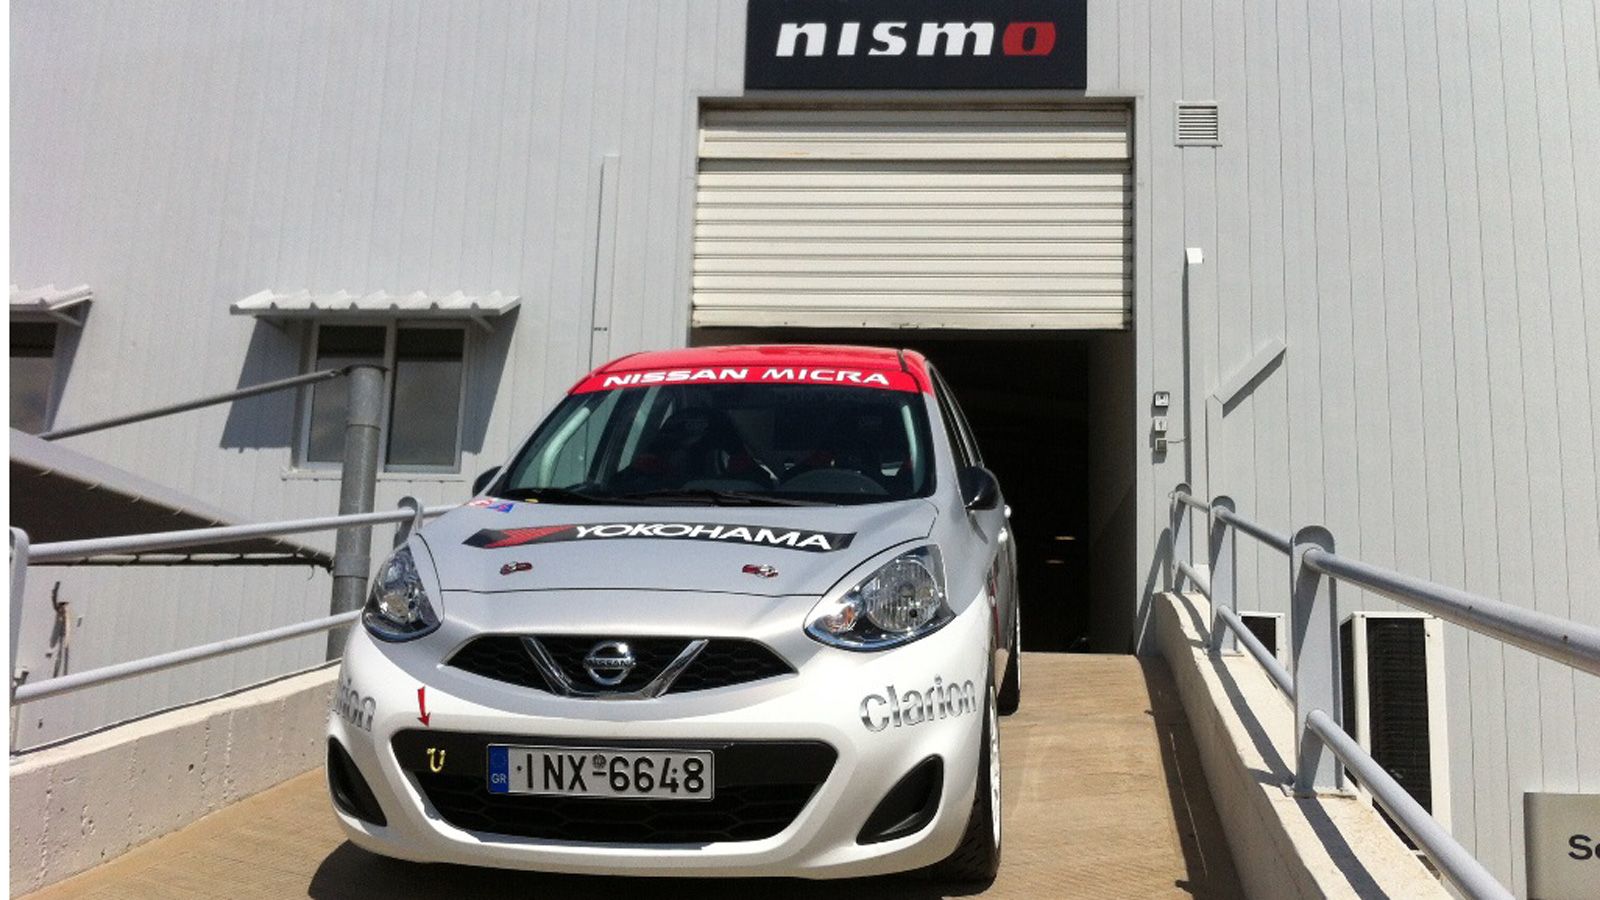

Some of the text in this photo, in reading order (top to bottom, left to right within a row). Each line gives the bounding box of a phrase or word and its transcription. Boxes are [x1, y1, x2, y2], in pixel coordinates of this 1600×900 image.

[776, 22, 1057, 57] nismo
[603, 367, 891, 388] NISSAN MICRA
[575, 523, 833, 550] YOKOHAMA
[859, 676, 977, 732] Clarion
[491, 773, 507, 785] GR
[1568, 834, 1600, 861] S
